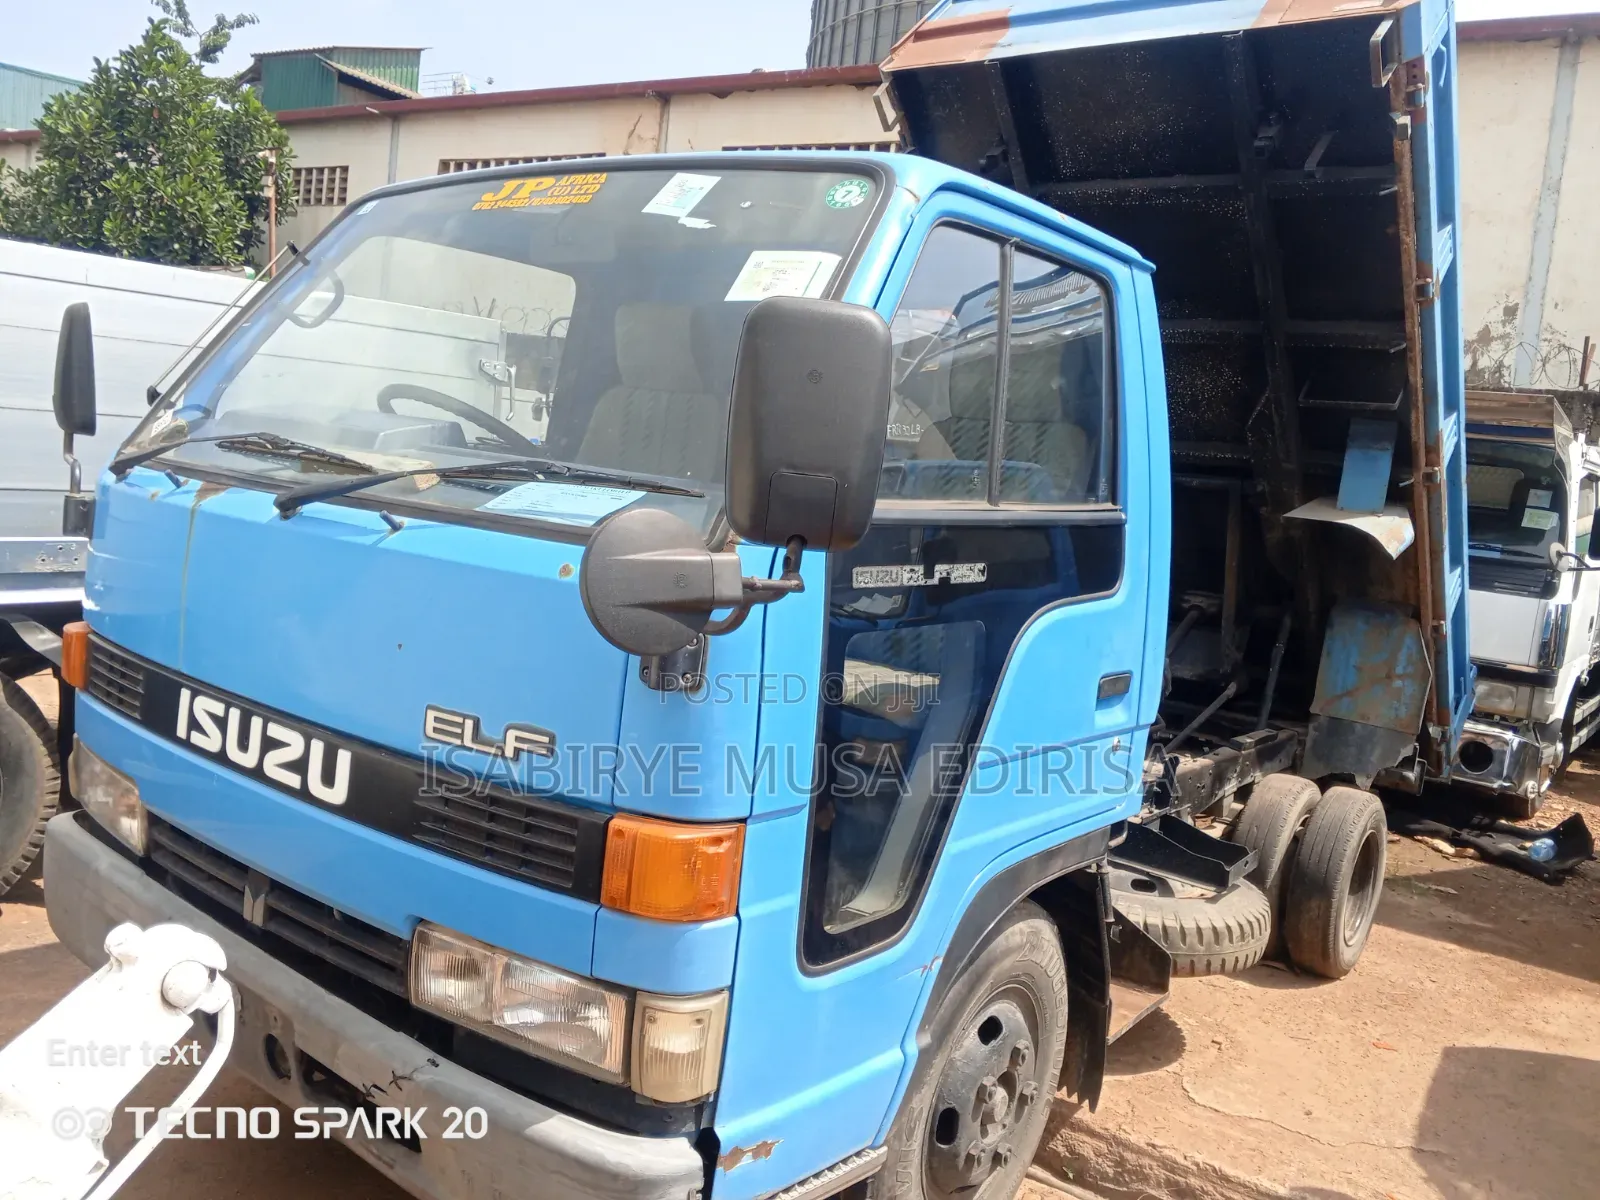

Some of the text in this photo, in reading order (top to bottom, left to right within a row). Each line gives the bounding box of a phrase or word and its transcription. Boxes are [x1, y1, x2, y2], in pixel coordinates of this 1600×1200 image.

[481, 177, 556, 201] JP
[547, 184, 601, 197] (U) LTD
[556, 172, 607, 186] AFRICA
[424, 707, 552, 759] ELF
[176, 687, 352, 806] ISUZU
